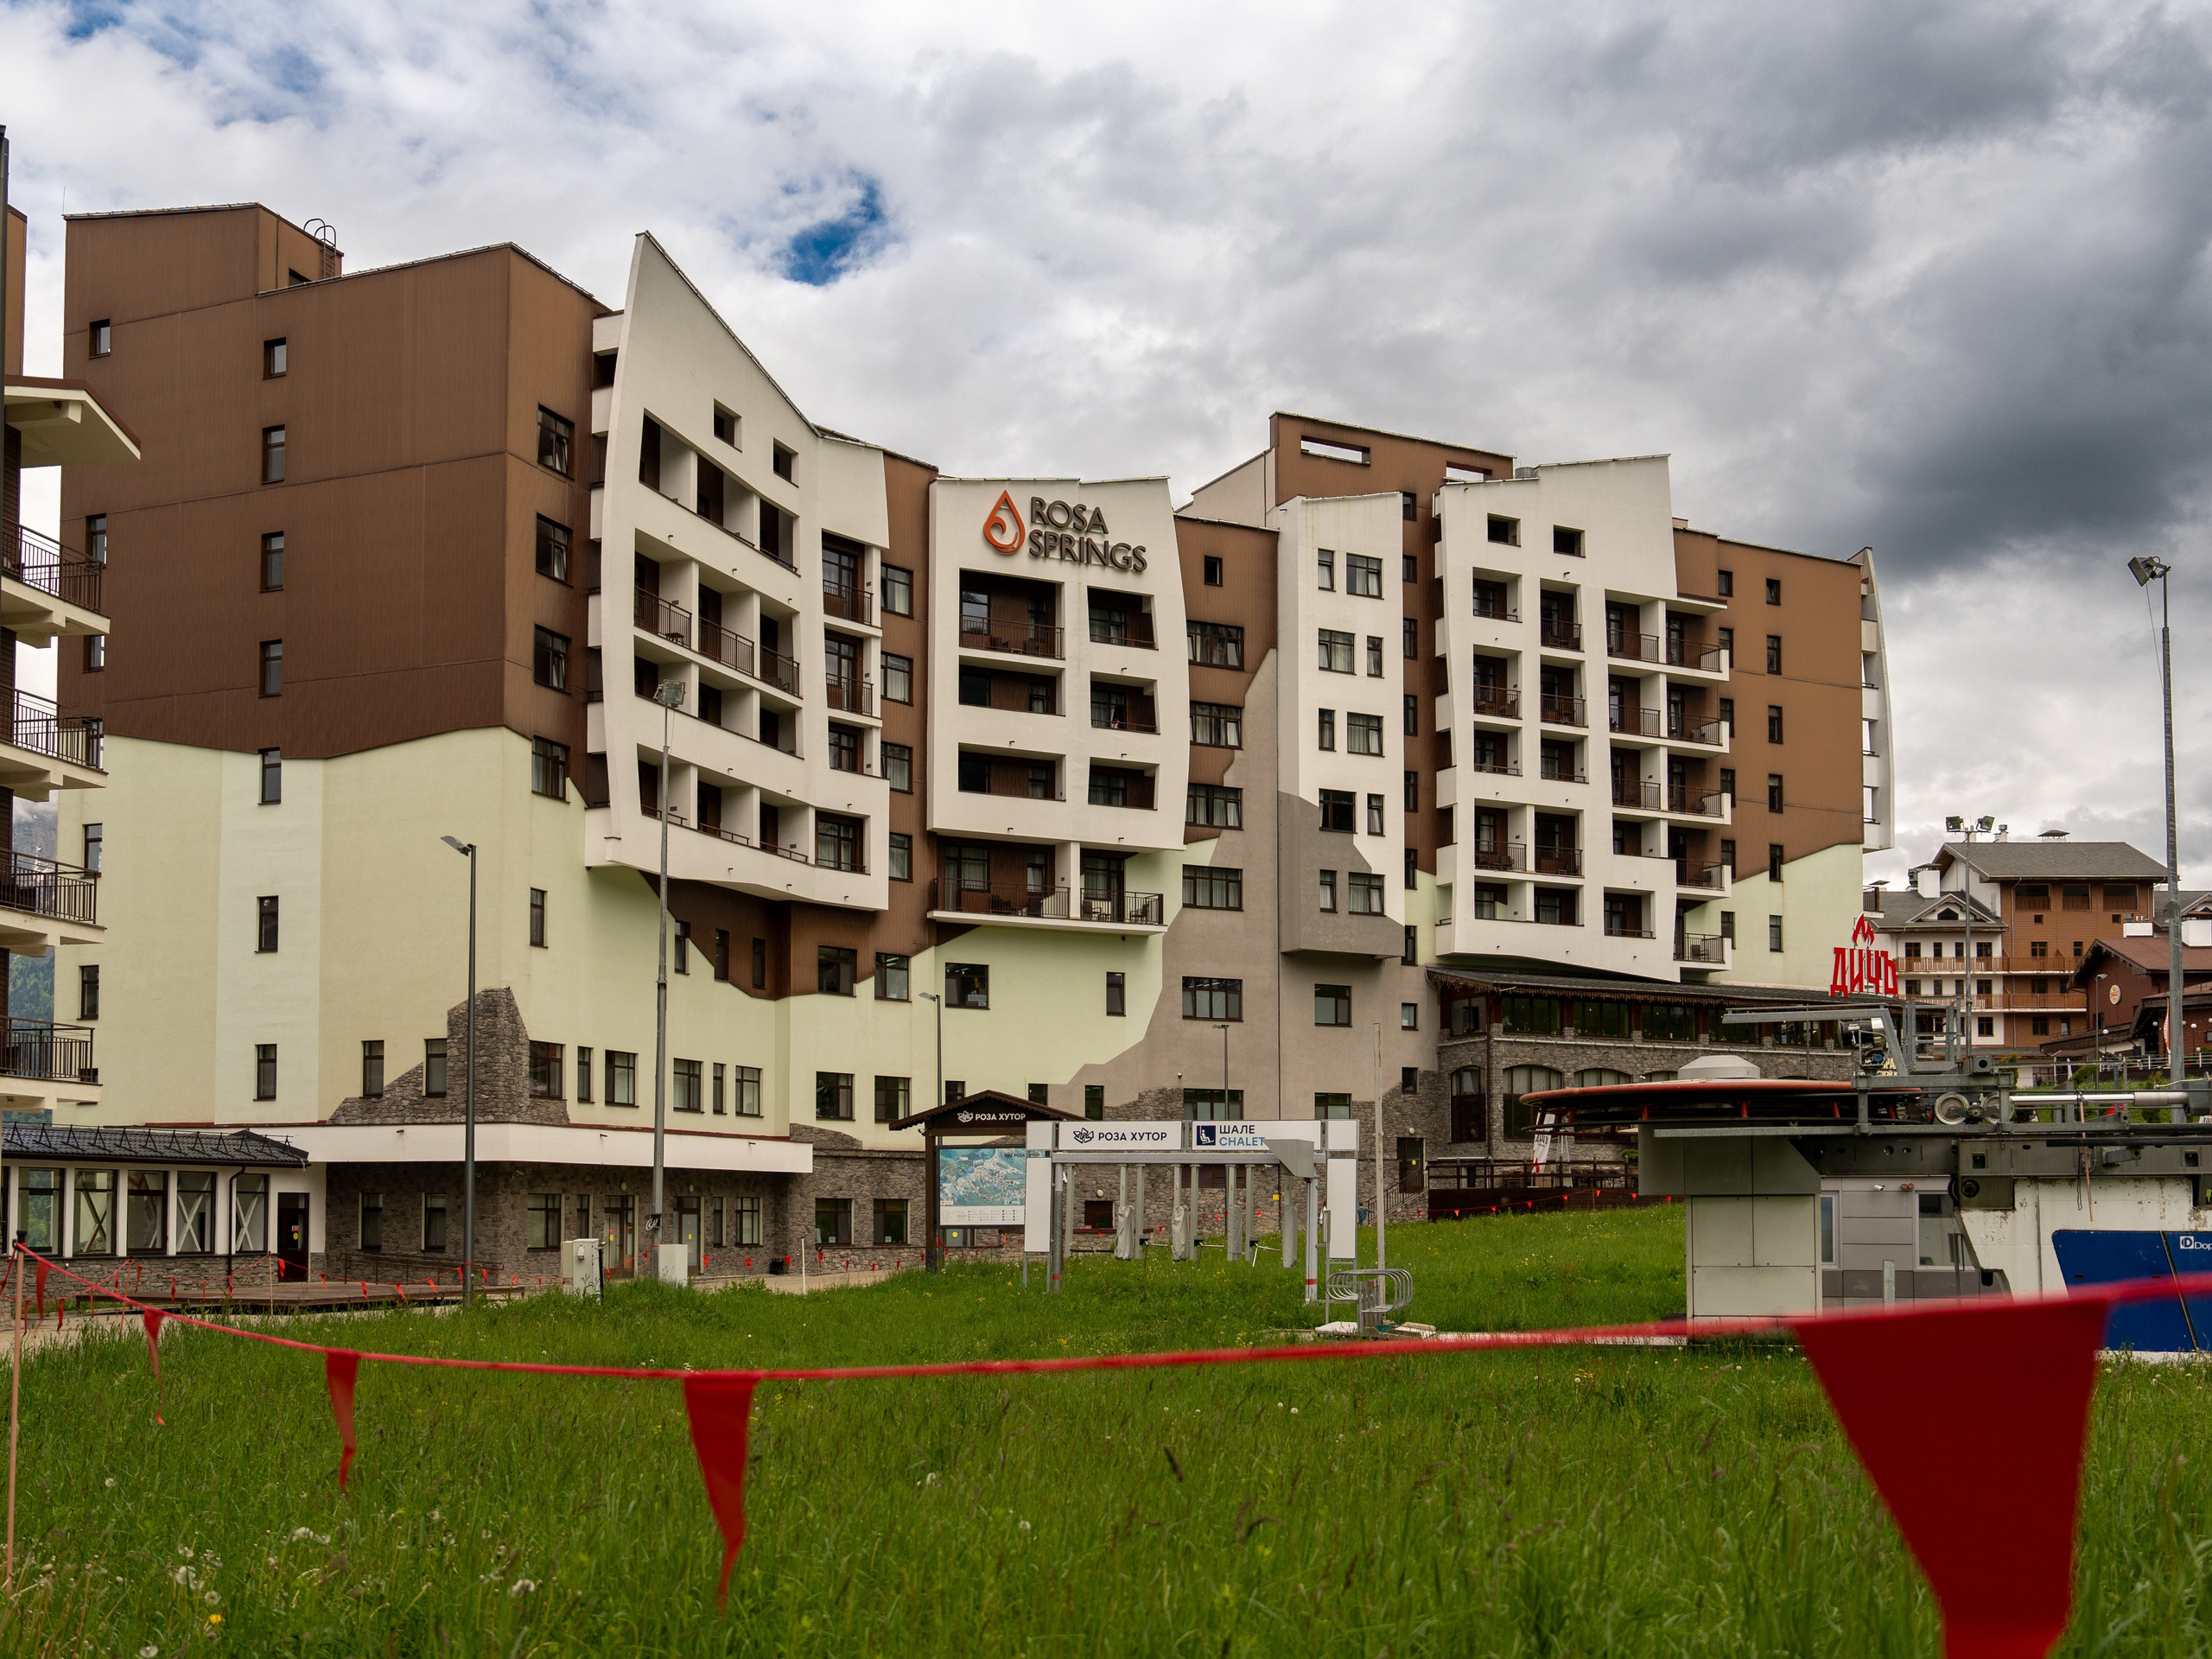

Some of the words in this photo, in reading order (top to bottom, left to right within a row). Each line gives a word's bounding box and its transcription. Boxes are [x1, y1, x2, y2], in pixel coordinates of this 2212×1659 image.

[1031, 496, 1109, 535] ROSA
[1029, 529, 1147, 572] SPRINGS
[1829, 947, 1899, 998] ДИЧЪ
[1098, 1132, 1127, 1141] РОЗА
[1130, 1132, 1167, 1141] ХУТОР
[1219, 1125, 1255, 1135] ШАЛЕ
[1219, 1136, 1266, 1147] CHALET
